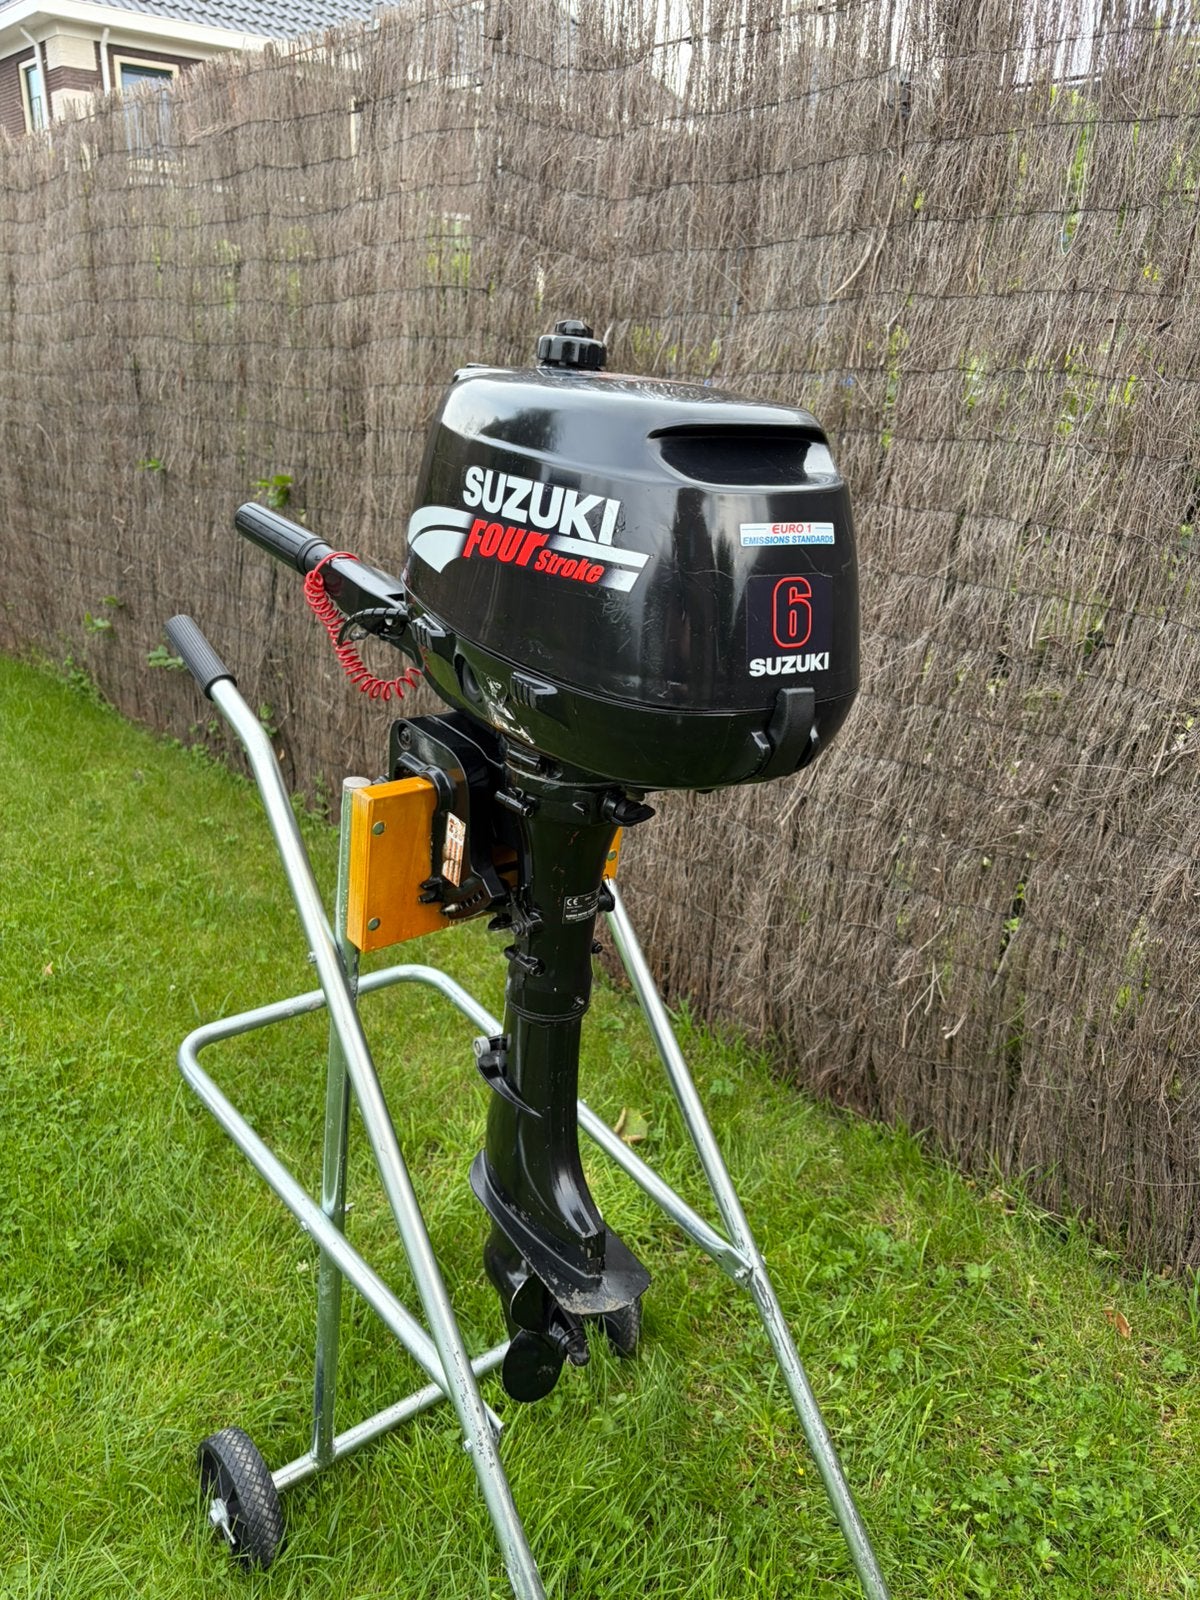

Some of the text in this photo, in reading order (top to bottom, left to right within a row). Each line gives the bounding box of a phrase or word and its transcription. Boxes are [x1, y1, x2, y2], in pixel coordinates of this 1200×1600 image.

[462, 466, 621, 546] SUZUKI
[743, 535, 834, 545] EMISSIONS STANDARDS
[771, 524, 812, 534] EURO 1
[534, 549, 605, 585] Stroke
[772, 576, 812, 649] 6
[749, 652, 830, 677] SUZUKI
